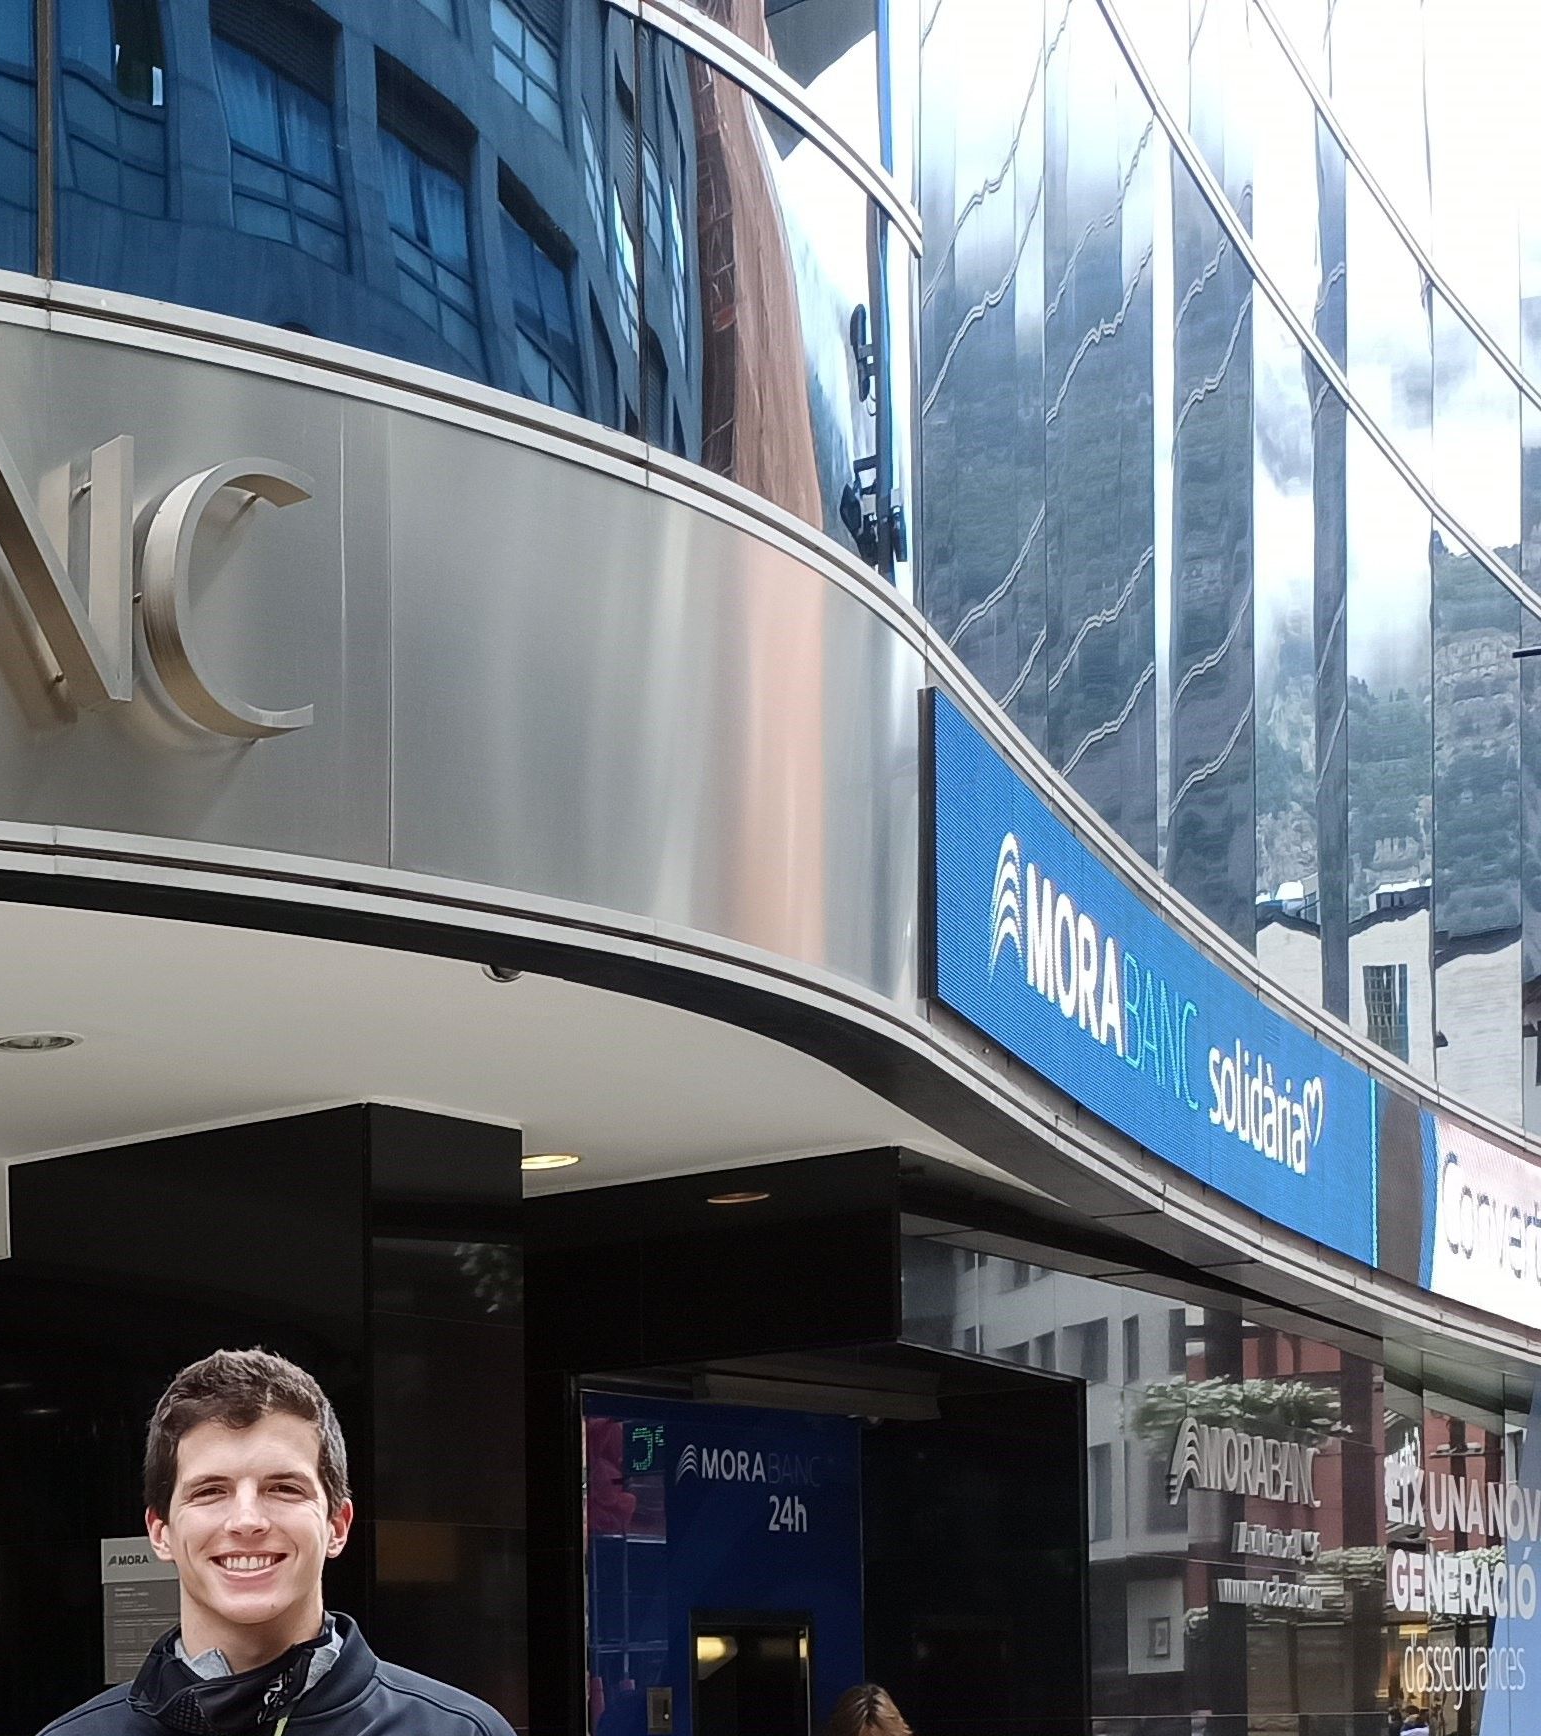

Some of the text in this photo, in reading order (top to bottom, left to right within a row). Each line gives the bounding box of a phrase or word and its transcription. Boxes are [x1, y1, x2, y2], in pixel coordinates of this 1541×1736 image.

[1027, 863, 1308, 1176] MORABANC solidària
[768, 1495, 809, 1533] 24h
[1429, 1471, 1485, 1536] UNA
[1488, 1481, 1541, 1543] NOV
[1391, 1547, 1536, 1621] GENERACIÓ
